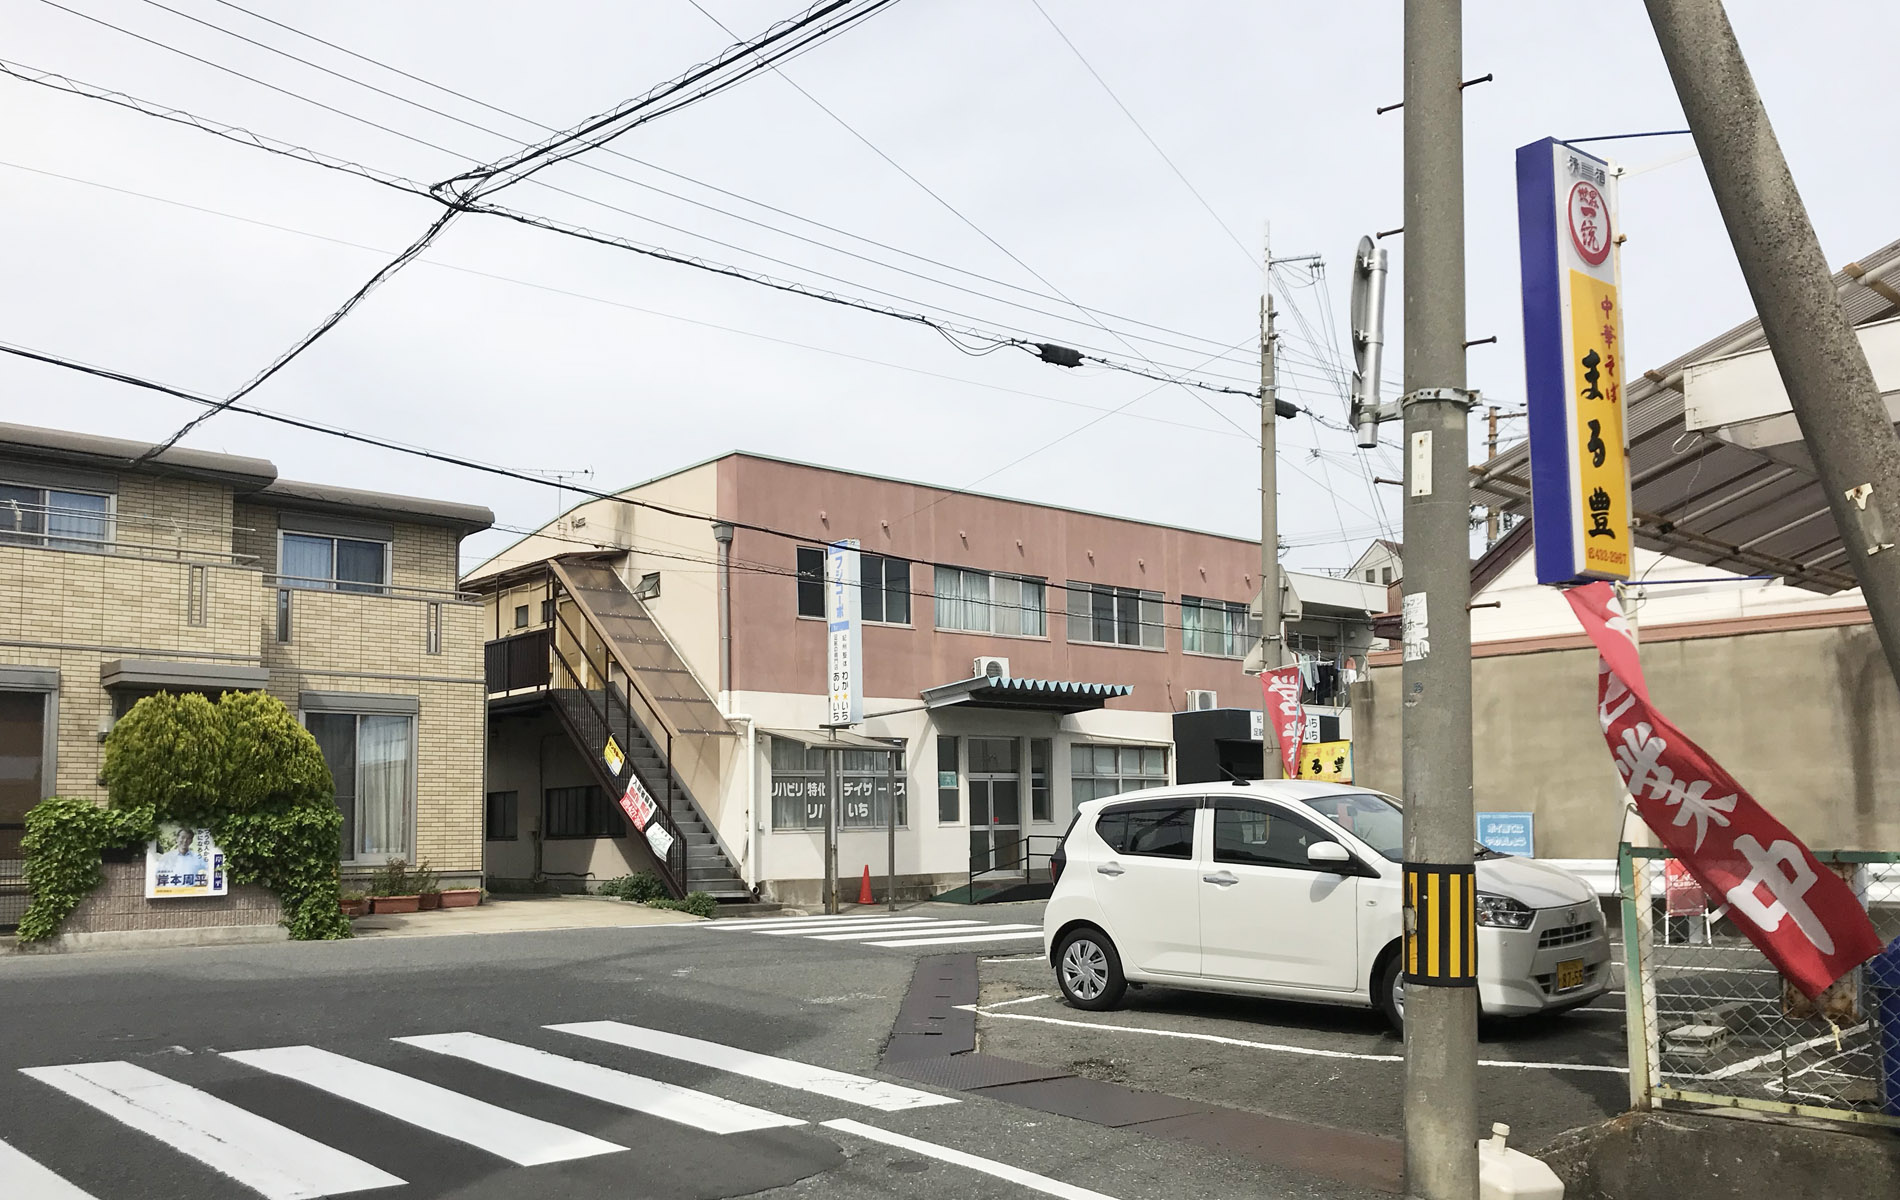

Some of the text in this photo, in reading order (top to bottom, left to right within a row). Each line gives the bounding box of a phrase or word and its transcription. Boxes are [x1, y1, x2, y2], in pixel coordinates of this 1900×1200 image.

[1600, 294, 1619, 404] 中華そば
[1581, 348, 1616, 540] まる豊
[156, 873, 209, 887] 岸本周平
